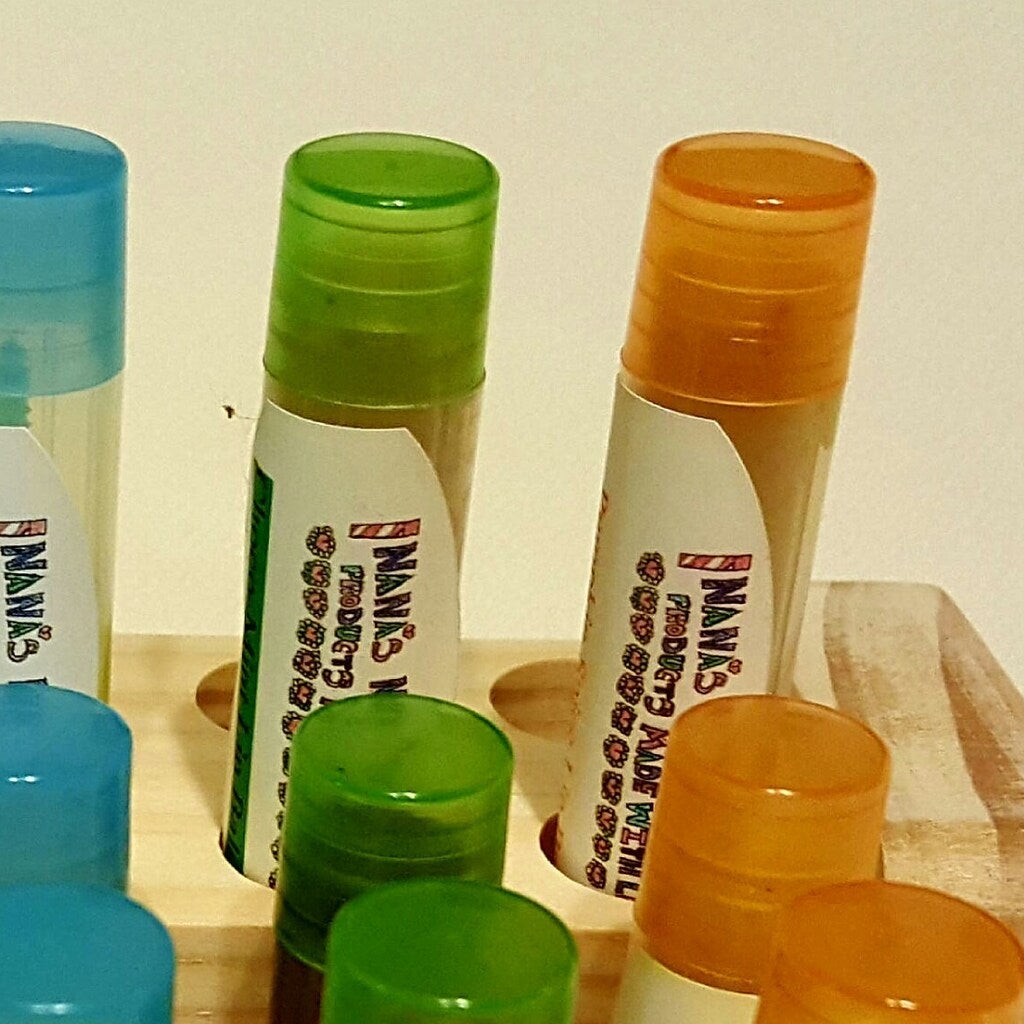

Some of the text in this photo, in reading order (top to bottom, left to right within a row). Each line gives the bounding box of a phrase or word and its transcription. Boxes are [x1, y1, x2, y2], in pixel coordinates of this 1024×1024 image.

[321, 565, 364, 689] PRODUCTS
[643, 593, 691, 718] PRODUCTS
[632, 722, 669, 799] MADE
[617, 801, 654, 878] WITH
